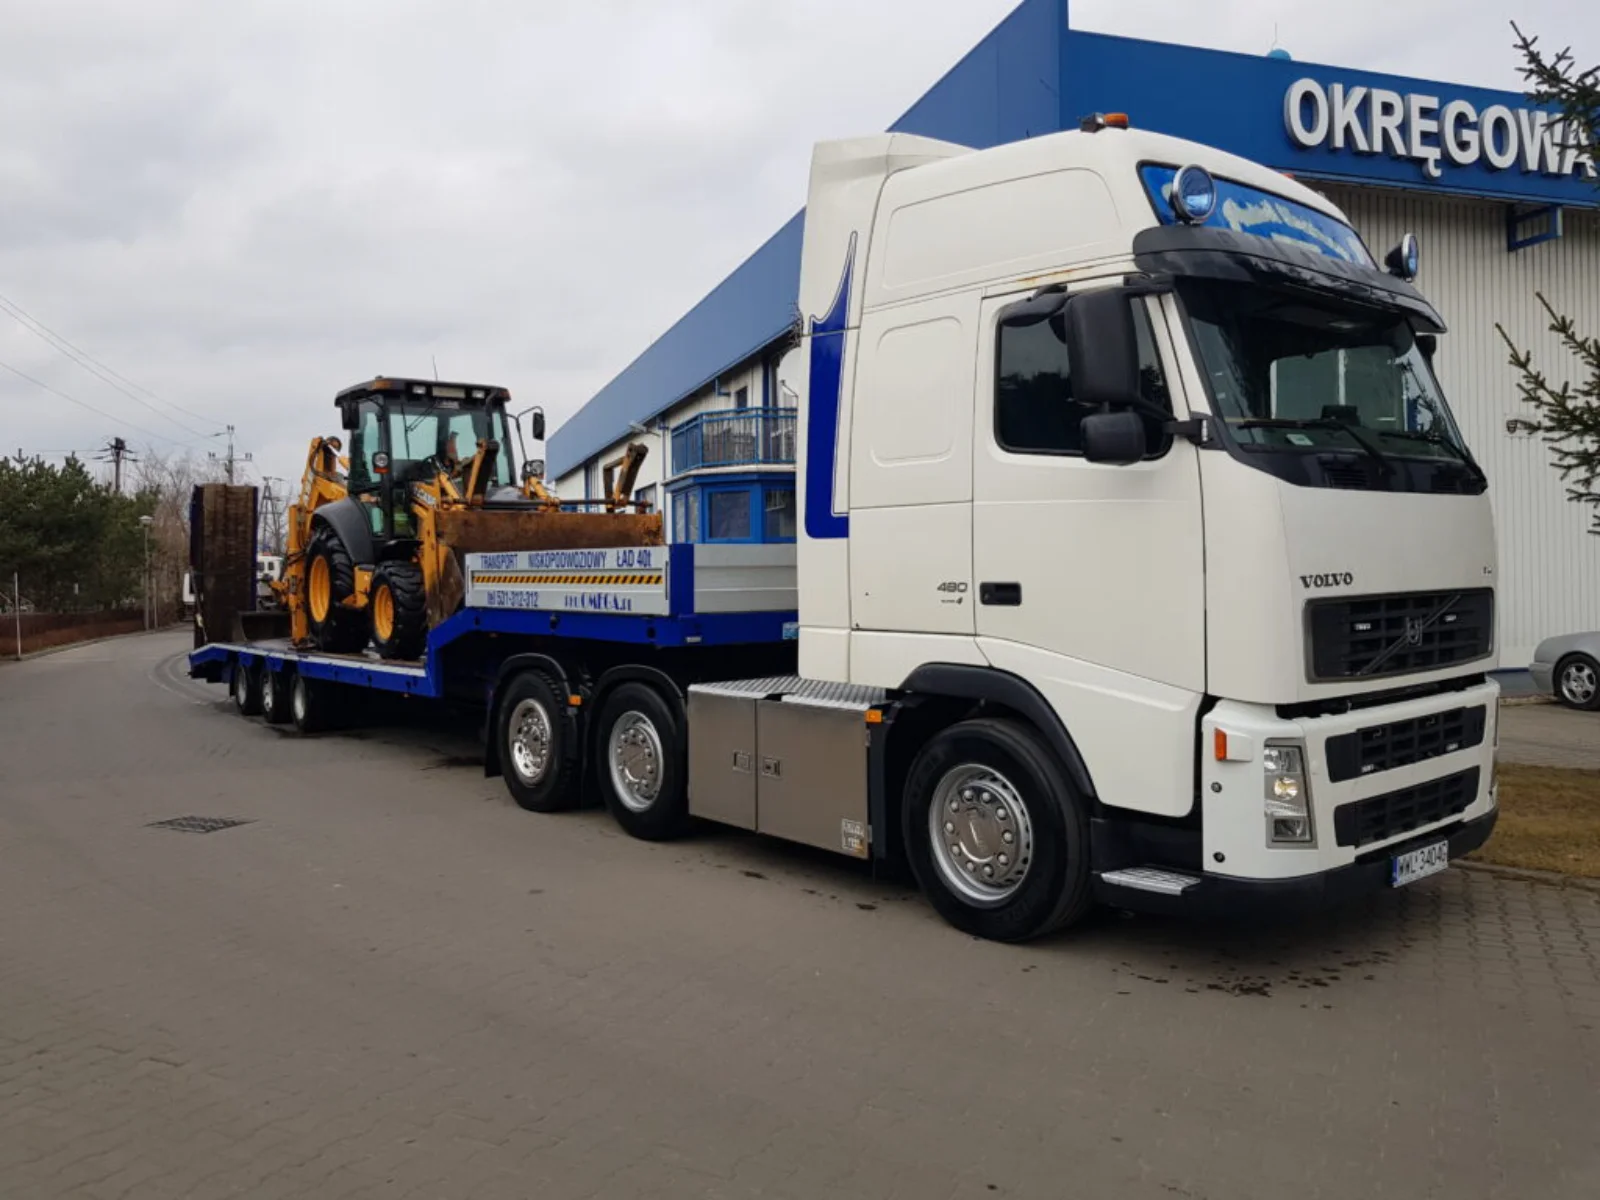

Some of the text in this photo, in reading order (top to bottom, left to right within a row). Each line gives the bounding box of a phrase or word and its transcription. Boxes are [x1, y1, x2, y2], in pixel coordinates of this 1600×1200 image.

[1284, 78, 1597, 178] OKRĘGOWA
[480, 554, 518, 570] TRANSPORT
[937, 582, 968, 593] 480
[1299, 572, 1353, 589] VOLVO
